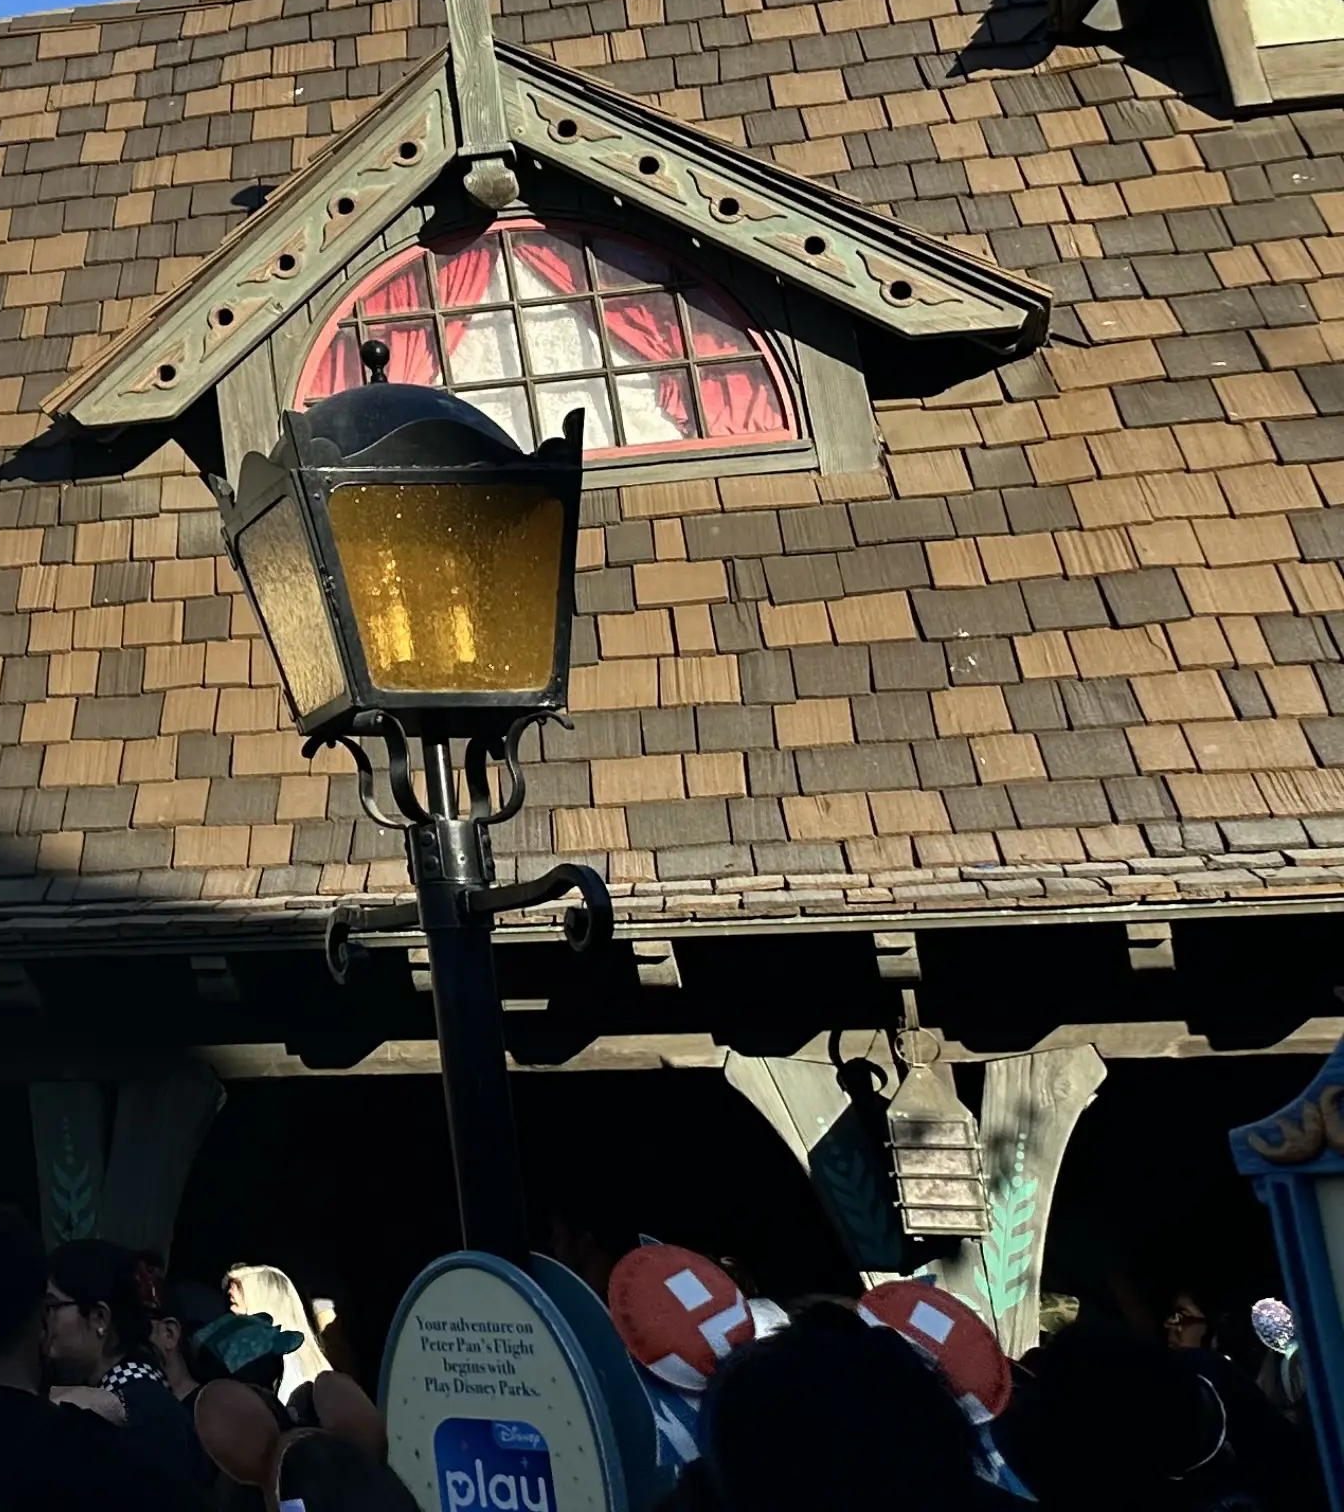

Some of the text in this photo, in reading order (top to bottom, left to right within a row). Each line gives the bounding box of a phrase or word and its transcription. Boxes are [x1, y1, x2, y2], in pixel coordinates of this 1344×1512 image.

[416, 1315, 534, 1334] Your adventure on
[421, 1336, 534, 1359] Peter Pan's Flight
[442, 1357, 516, 1377] begins with
[424, 1377, 541, 1399] Play Disney Parks.
[445, 1458, 549, 1512] play
